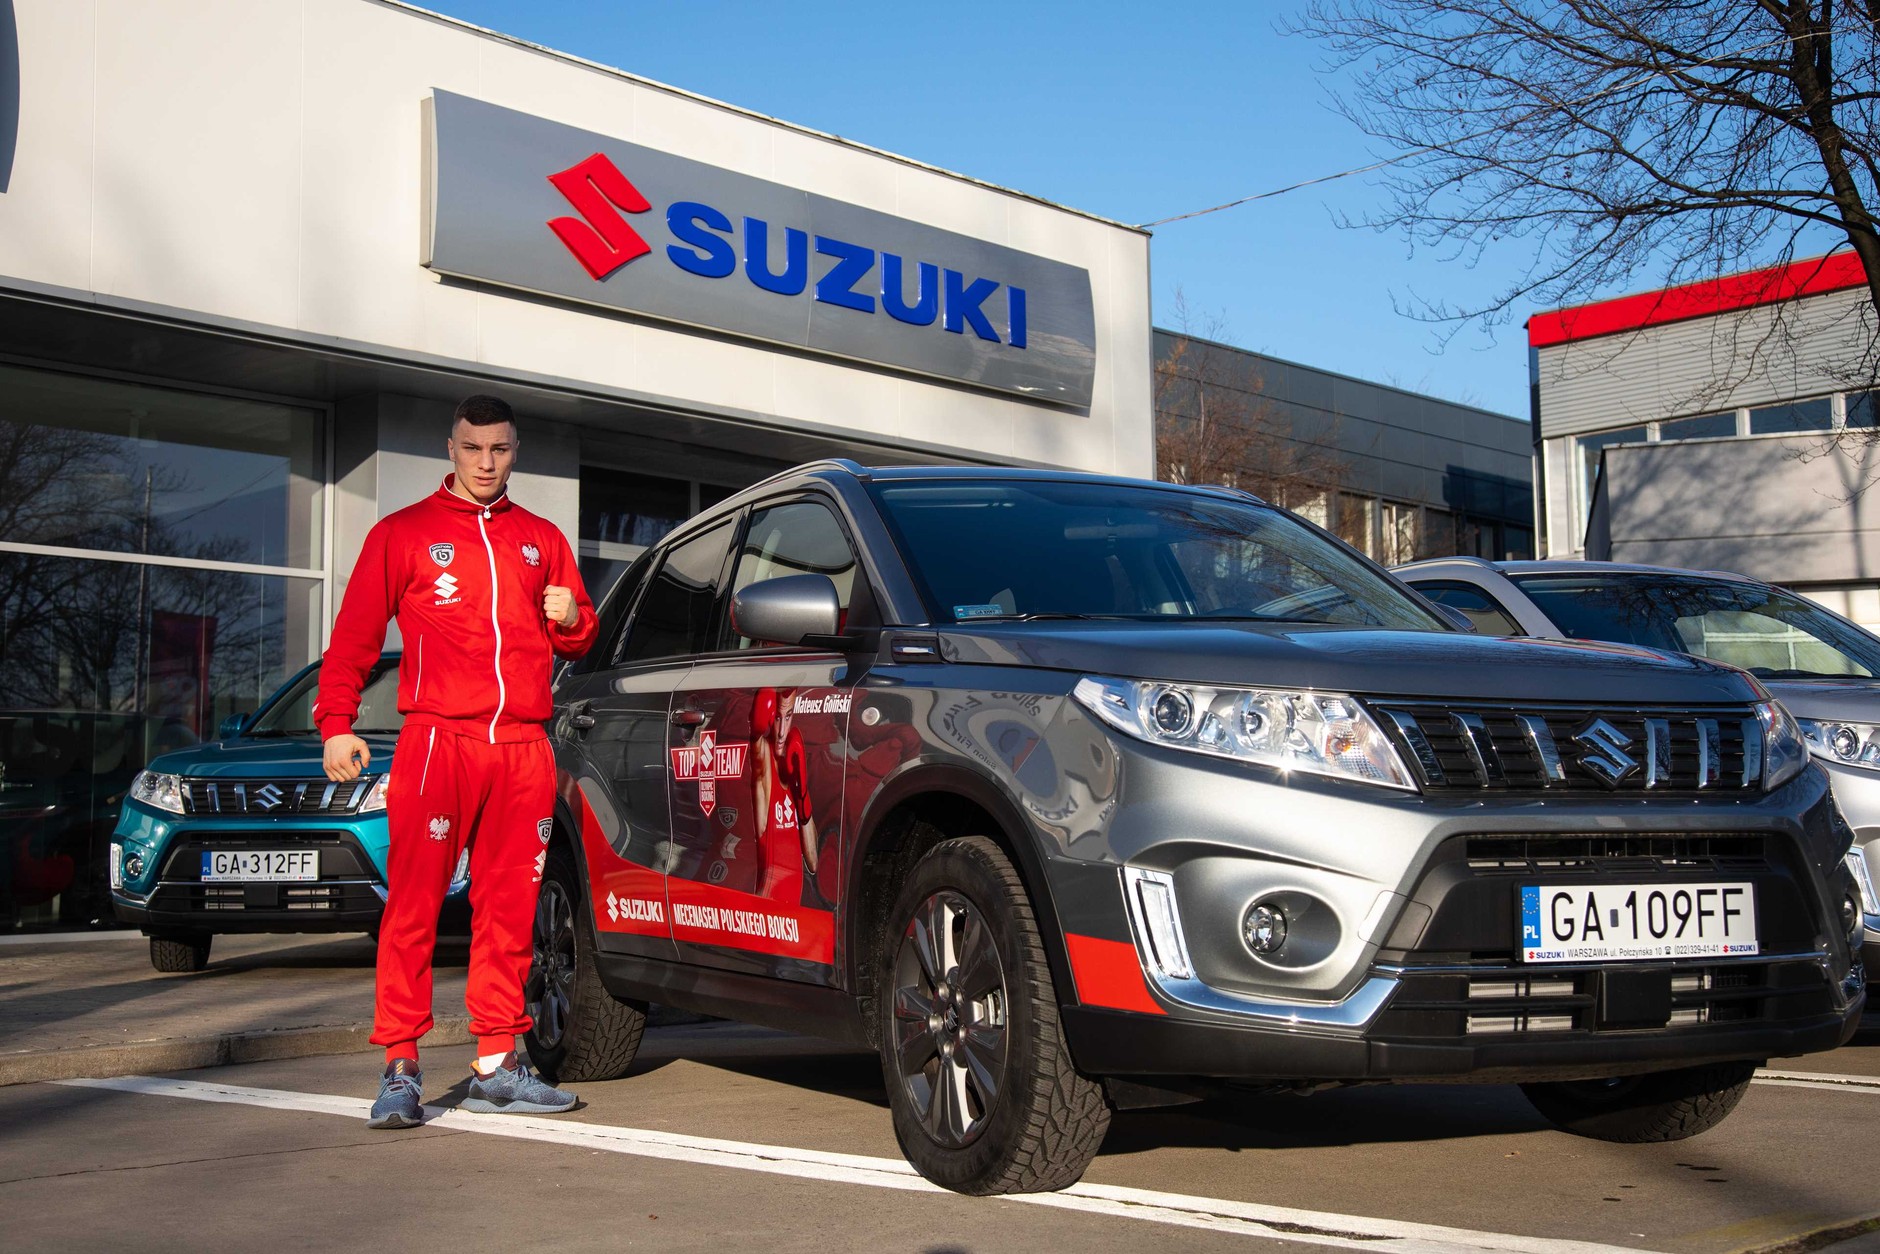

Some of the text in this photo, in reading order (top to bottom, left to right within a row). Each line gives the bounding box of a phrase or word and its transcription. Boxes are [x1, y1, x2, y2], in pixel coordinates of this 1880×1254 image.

[666, 201, 1027, 348] SUZUKI
[434, 597, 462, 606] SUZUKI
[793, 696, 823, 714] Mateusz
[678, 747, 741, 777] TOP TEAM
[215, 853, 313, 874] GA 312FF
[619, 897, 665, 923] SUZUKI
[1551, 888, 1744, 942] GA 109FF
[673, 903, 800, 944] MECENASEM POLSKIEGO BOKSU
[1523, 925, 1539, 939] PL
[1536, 951, 1565, 959] SUZUKI
[1568, 947, 1609, 958] WARSZAWA
[1655, 946, 1663, 956] 10
[1729, 944, 1756, 953] SUZUKI
